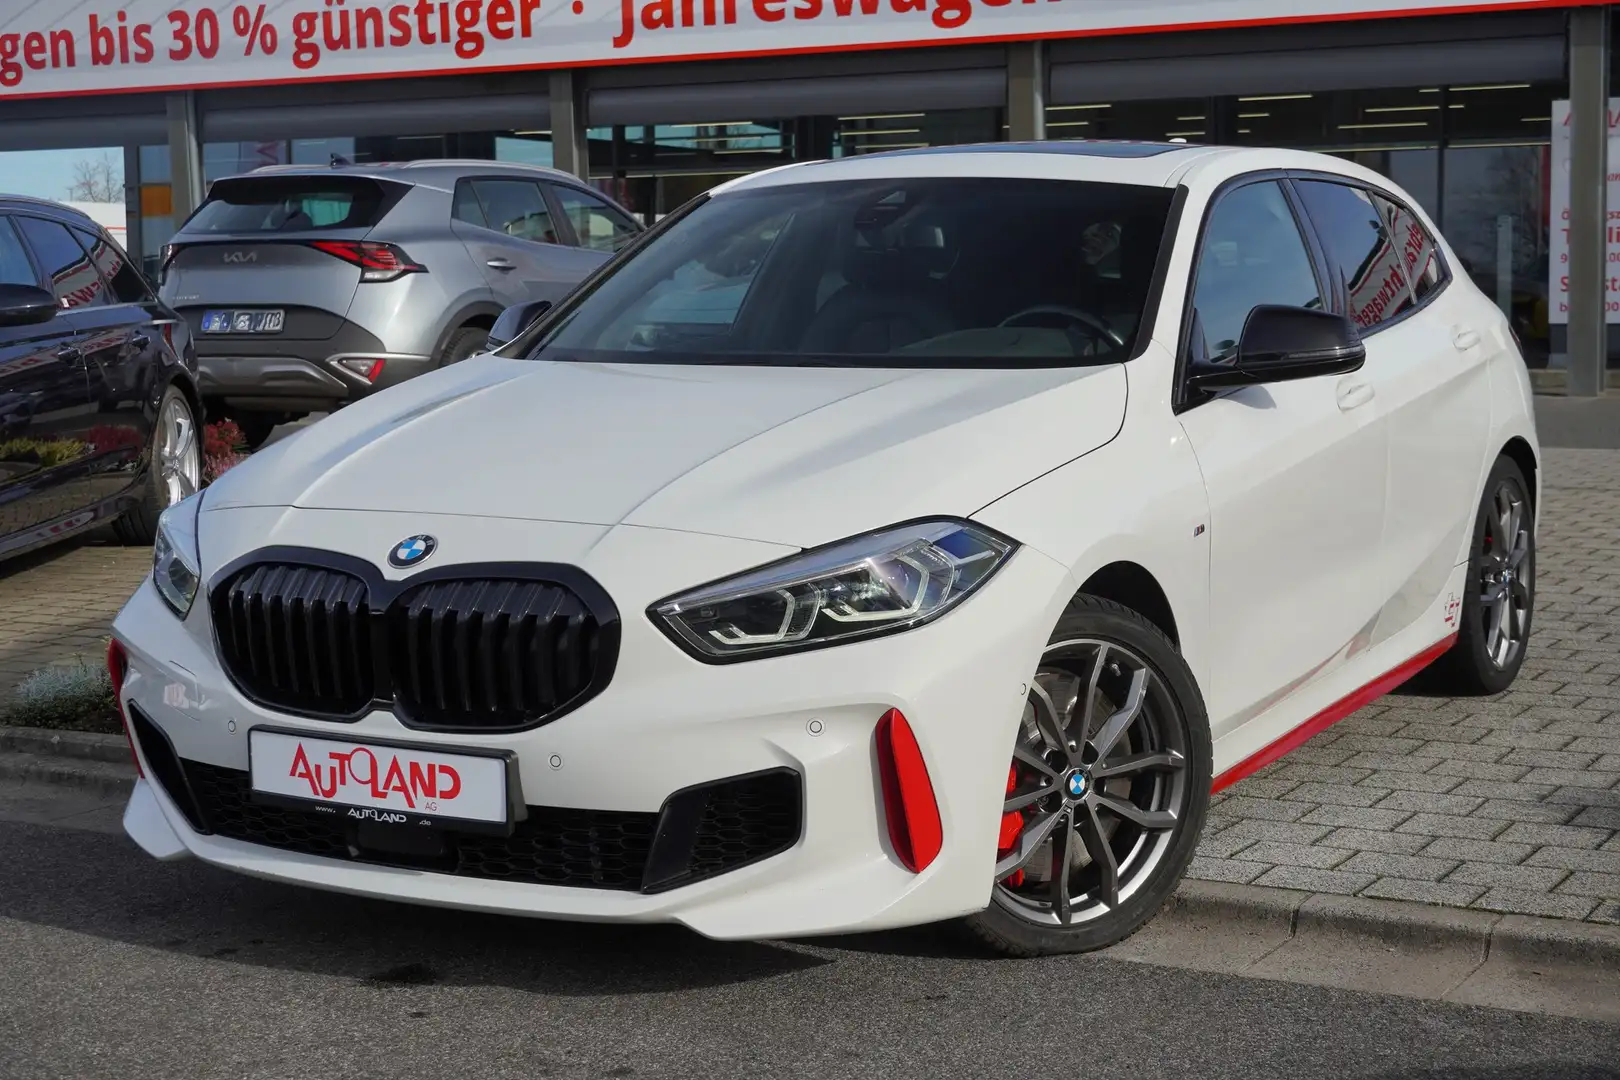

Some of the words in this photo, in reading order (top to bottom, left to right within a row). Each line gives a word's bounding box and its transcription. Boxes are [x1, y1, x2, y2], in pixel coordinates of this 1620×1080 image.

[0, 29, 76, 87] gen
[88, 10, 154, 66] bis
[167, 8, 220, 61] 30
[233, 4, 278, 56] %
[292, 0, 541, 69] günstiger
[424, 801, 438, 812] AG
